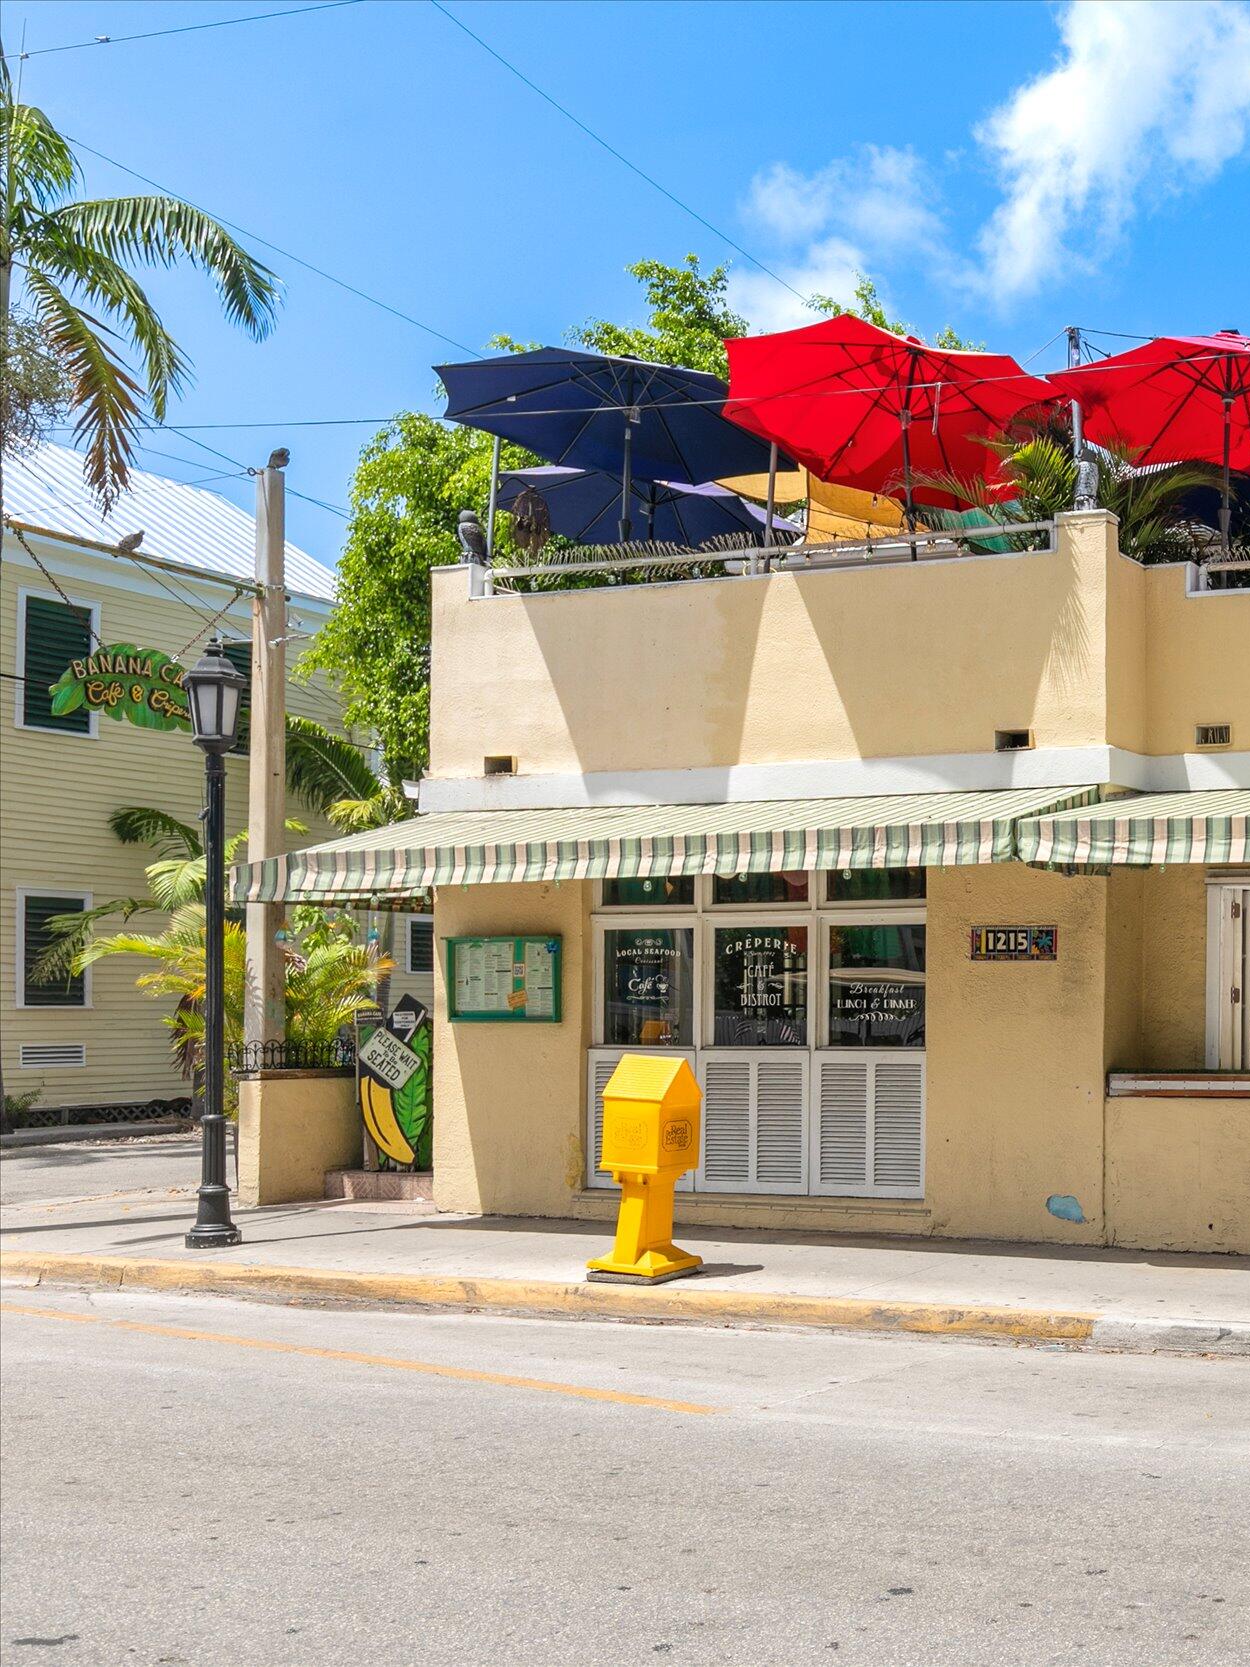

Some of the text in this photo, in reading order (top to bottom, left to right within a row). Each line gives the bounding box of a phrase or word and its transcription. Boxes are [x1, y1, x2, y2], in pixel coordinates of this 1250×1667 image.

[72, 653, 153, 679] BANANA
[86, 681, 125, 706] Café
[132, 684, 145, 702] &
[725, 933, 797, 955] CRÊPERIE
[987, 932, 1028, 950] 1215
[615, 948, 681, 958] LOCAL SEAFOOD
[747, 961, 775, 978] CAFÉ
[628, 976, 655, 995] Café
[757, 980, 765, 991] &
[849, 982, 905, 998] Breakfast
[740, 993, 782, 1007] BISTROT
[837, 997, 918, 1009] LUNCH & DINNER
[373, 1030, 418, 1070] PLEASE WAIT
[367, 1049, 401, 1081] SEATED
[670, 1123, 688, 1135] Real
[665, 1134, 689, 1146] Estate
